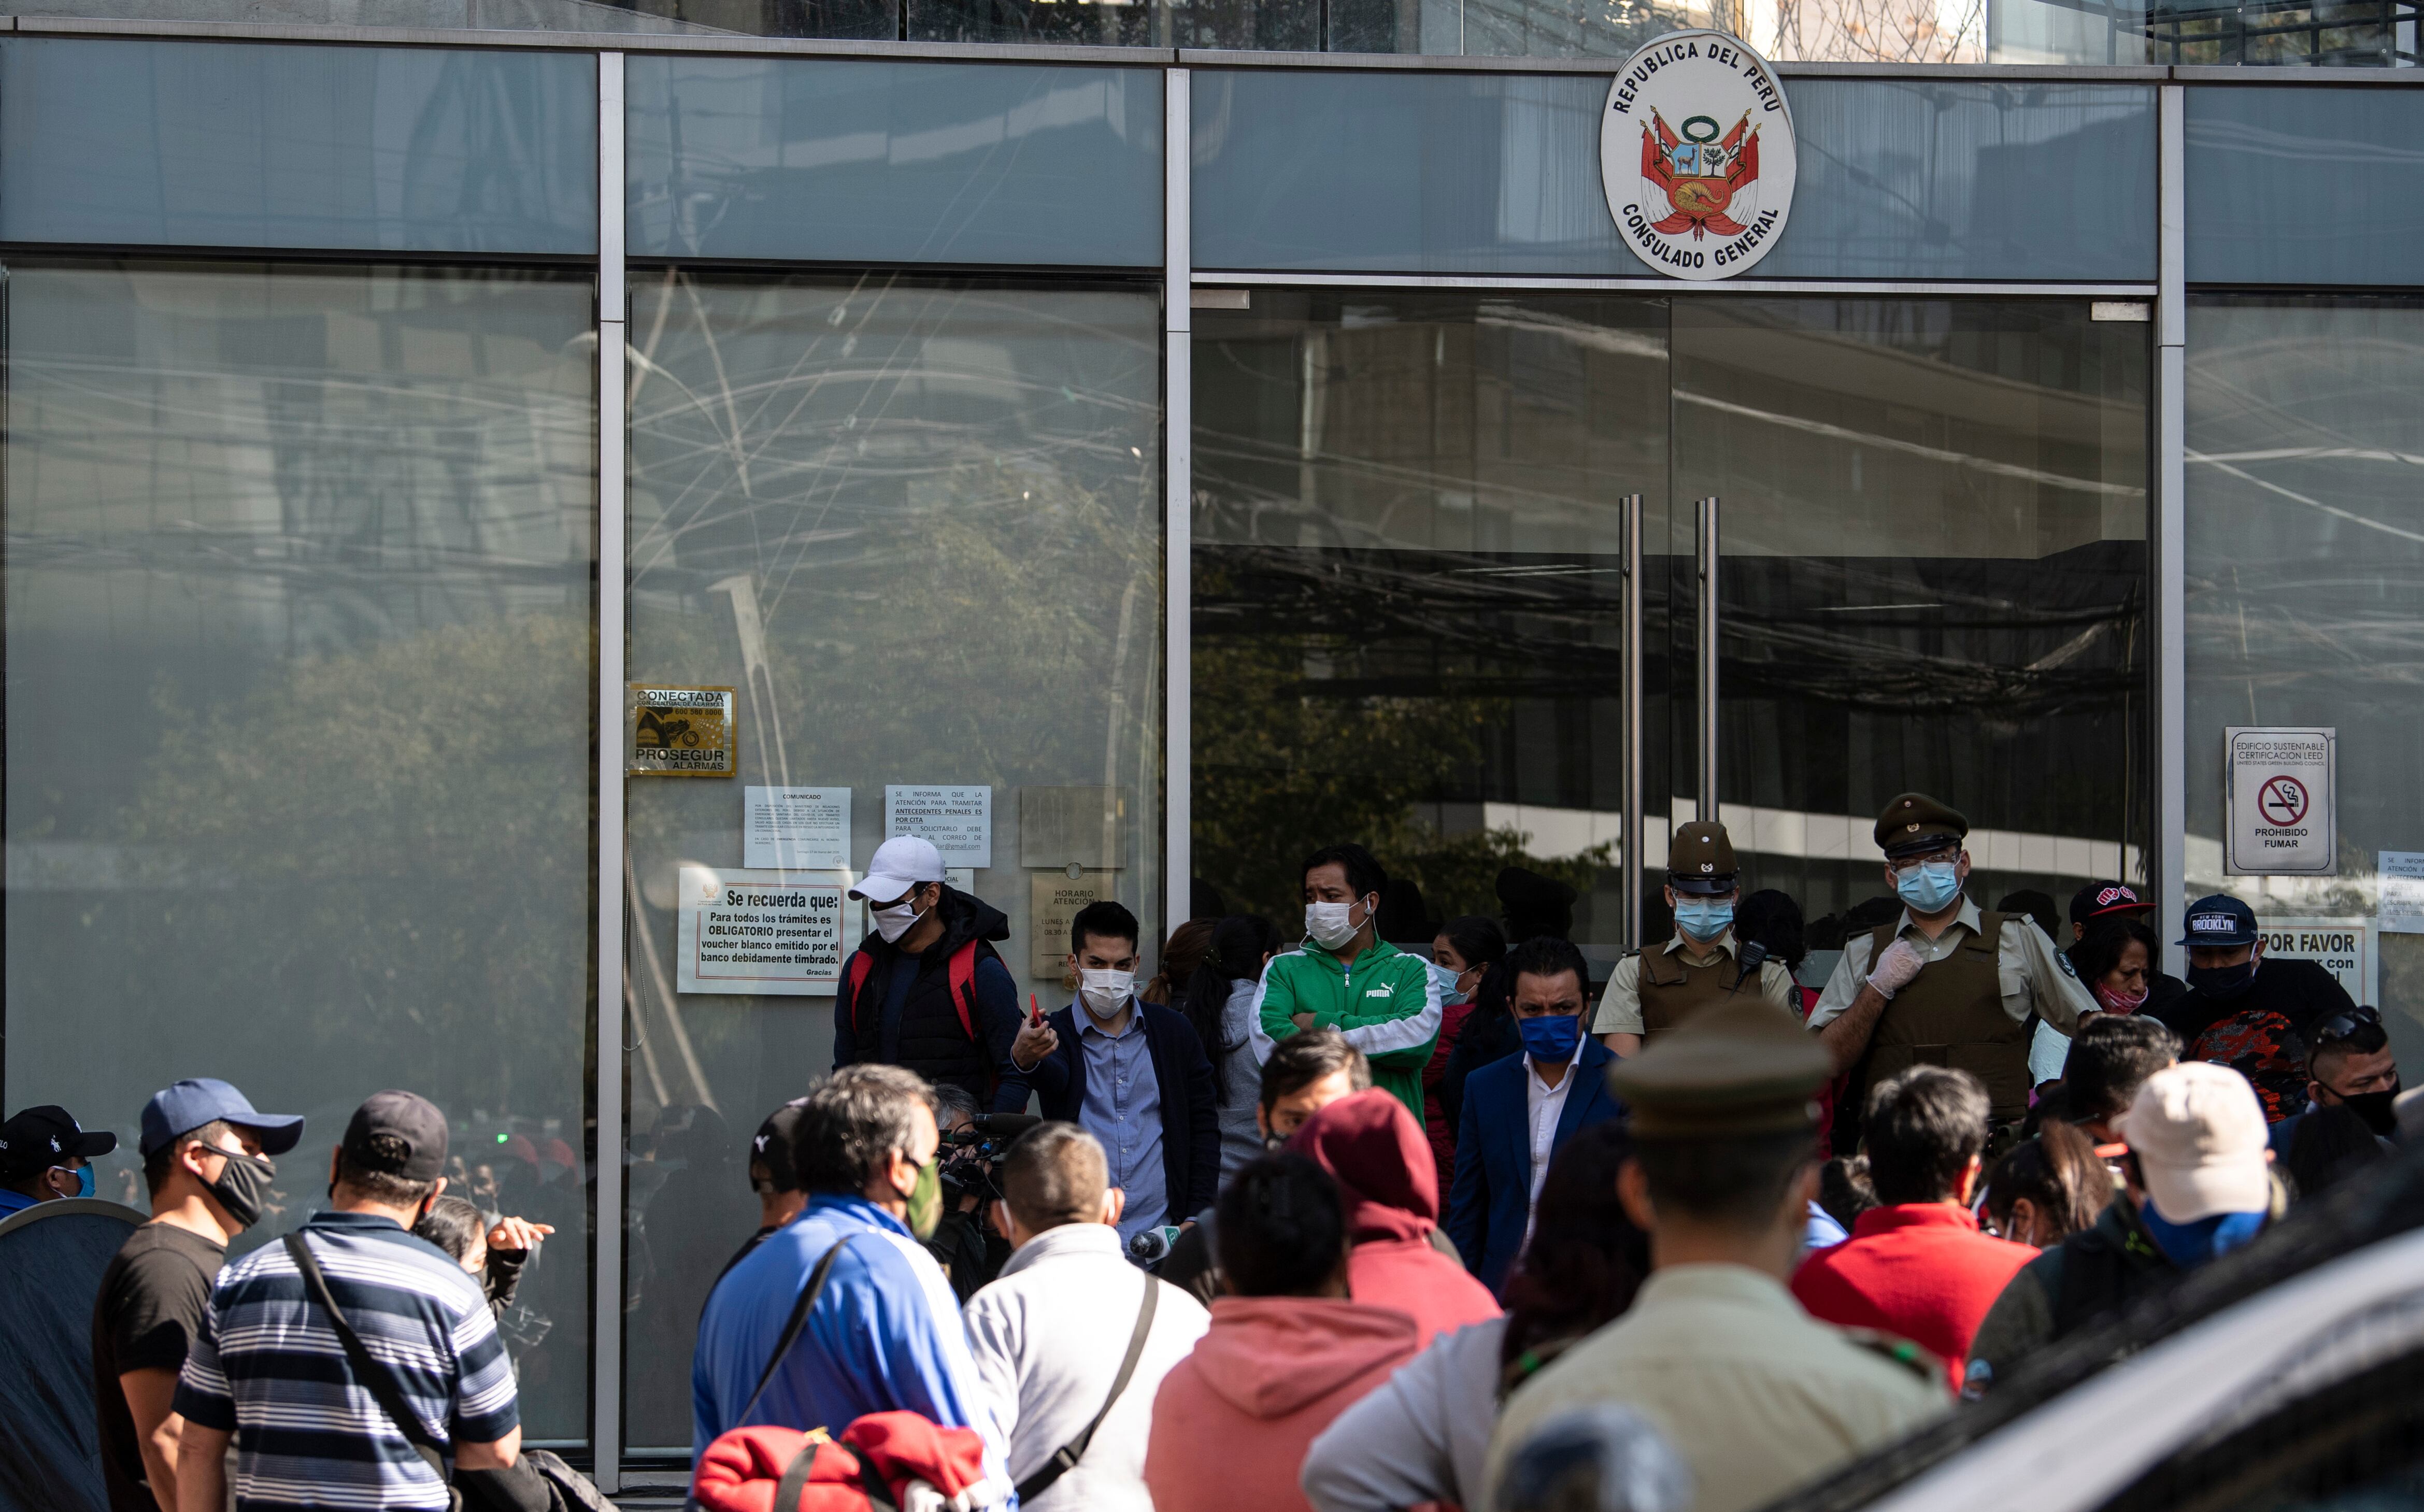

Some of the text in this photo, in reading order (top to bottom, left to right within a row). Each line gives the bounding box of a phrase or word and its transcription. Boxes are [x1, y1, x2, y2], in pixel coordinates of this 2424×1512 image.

[1613, 41, 1780, 113] REPUBLICA DEL PERU
[1623, 203, 1779, 269] CONSULADO GENERAL
[637, 691, 724, 702] CONECTADA
[636, 749, 724, 761] PROSEGUR
[673, 762, 724, 770] ALARMAS
[2255, 828, 2308, 836] PROHIBIDO
[727, 890, 838, 911] Se recuerda que:
[710, 912, 731, 922] Para
[734, 913, 759, 922] todos
[762, 914, 776, 923] los
[779, 914, 817, 924] trámites
[2192, 919, 2234, 931] BROOKLYN
[709, 925, 832, 938] OBLIGATORIO presentar el
[702, 939, 838, 953] voucher blanco emitido por el
[2260, 933, 2294, 951] POR
[2300, 934, 2355, 952] FAVOR
[701, 952, 838, 964] banco debidamente timbrado.
[2327, 959, 2354, 968] con
[1366, 989, 1390, 998] PUMA
